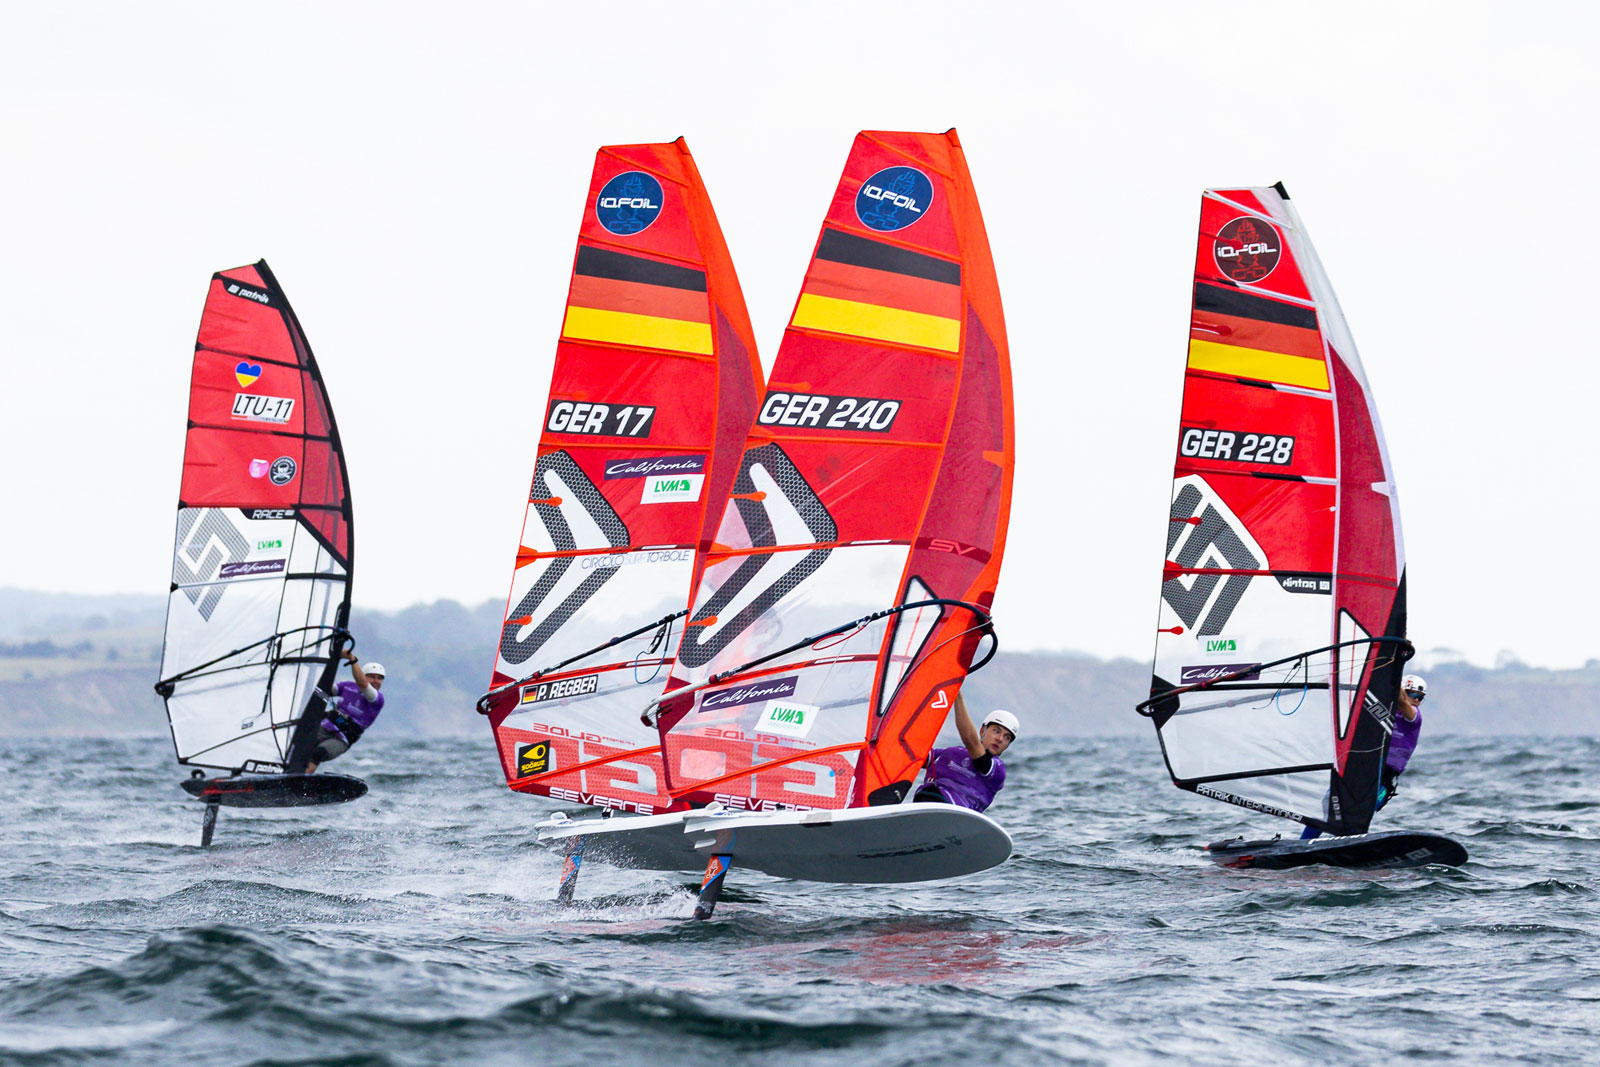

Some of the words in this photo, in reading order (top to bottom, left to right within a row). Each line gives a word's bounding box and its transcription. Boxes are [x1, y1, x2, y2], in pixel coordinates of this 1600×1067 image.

[233, 395, 293, 418] LTU-11
[759, 393, 830, 426] GER
[826, 398, 900, 430] 240
[548, 402, 610, 434] GER
[615, 406, 655, 436] 17
[1181, 428, 1236, 460] GER
[1238, 434, 1294, 464] 228
[606, 458, 702, 475] California
[654, 480, 680, 493] LVM
[252, 509, 285, 519] RACE
[221, 562, 284, 575] California
[1206, 640, 1227, 652] LVM
[537, 684, 547, 701] P.
[549, 676, 598, 699] REGBER
[702, 683, 794, 707] California
[770, 707, 796, 723] LVM
[549, 786, 654, 816] SEVERNE
